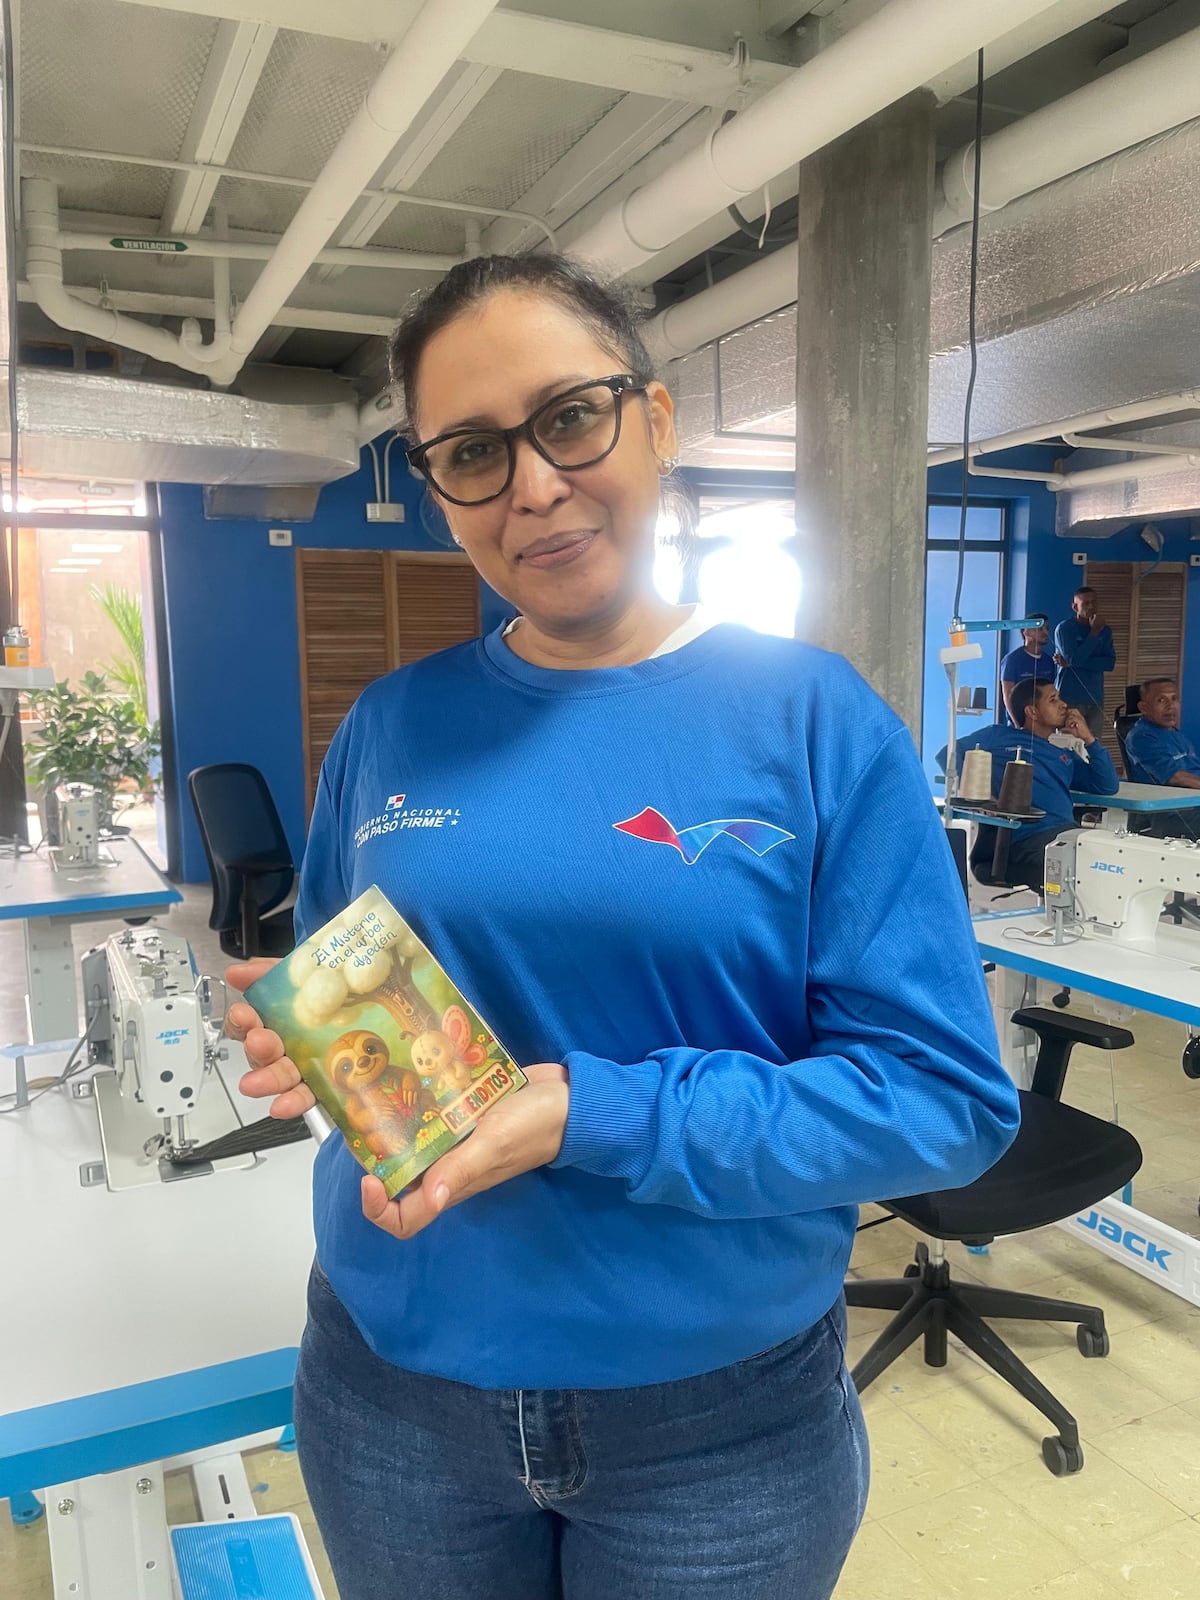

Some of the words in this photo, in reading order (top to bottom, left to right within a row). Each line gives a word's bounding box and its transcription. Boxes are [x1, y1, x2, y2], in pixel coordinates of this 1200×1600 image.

[393, 808, 461, 819] NACIONAL
[370, 820, 398, 839] PASO
[400, 817, 446, 830] FIRME
[311, 947, 330, 966] El
[330, 911, 376, 952] Misterio
[328, 955, 346, 969] en
[344, 945, 355, 958] el
